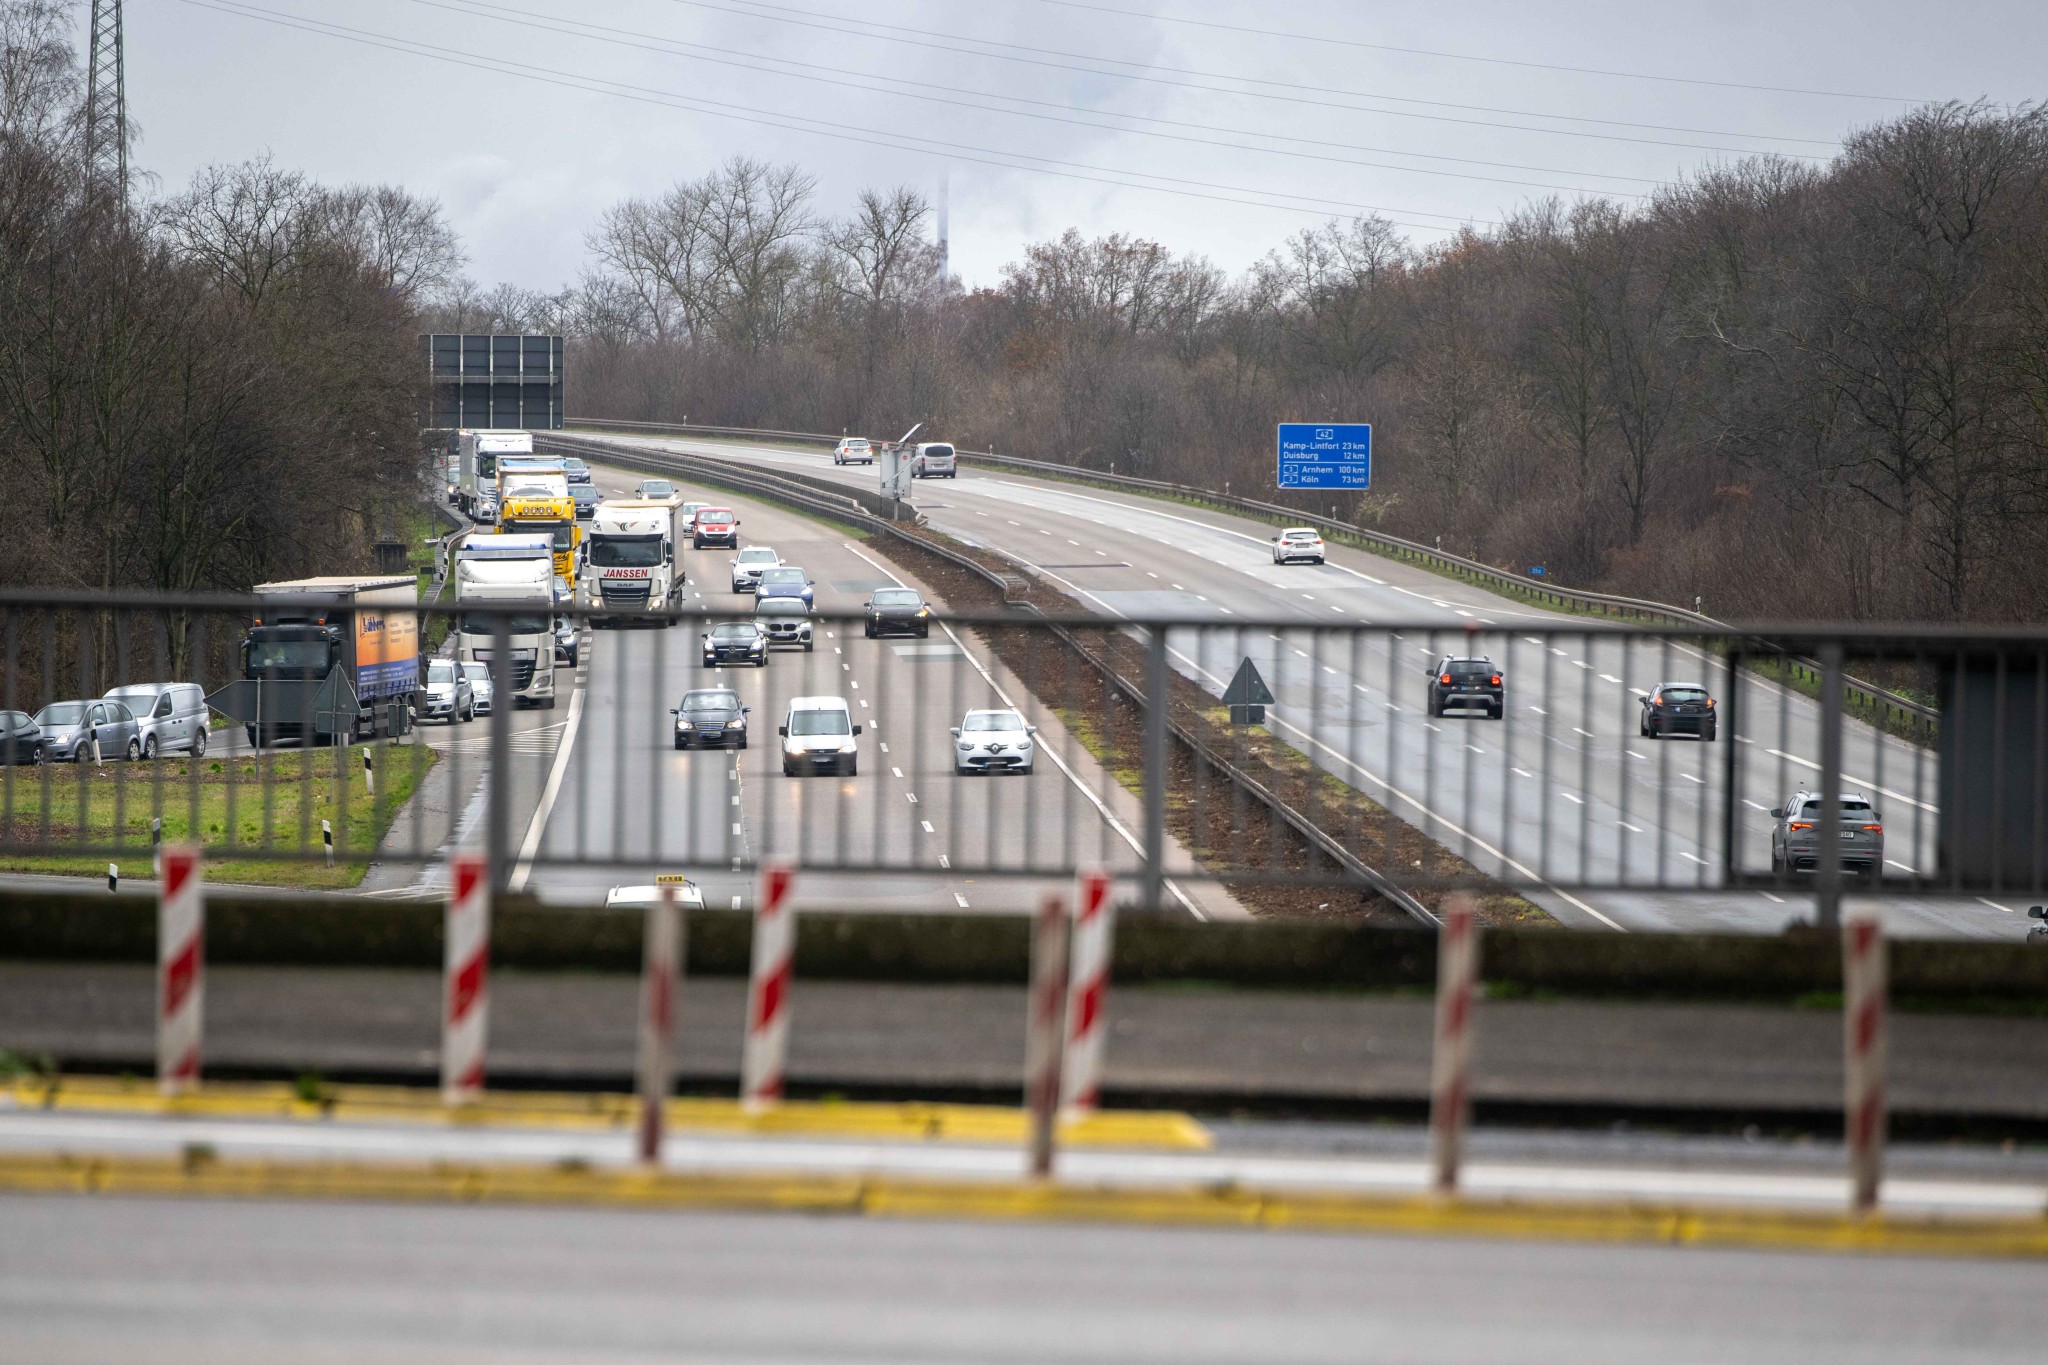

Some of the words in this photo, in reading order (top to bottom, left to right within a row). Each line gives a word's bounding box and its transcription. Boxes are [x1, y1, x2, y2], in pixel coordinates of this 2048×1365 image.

[1283, 442, 1339, 450] Kamp-Lintfort
[1283, 452, 1319, 461] Duisburg
[1352, 466, 1365, 474] km
[1301, 475, 1319, 483] Köln
[603, 569, 648, 578] JANSSEN
